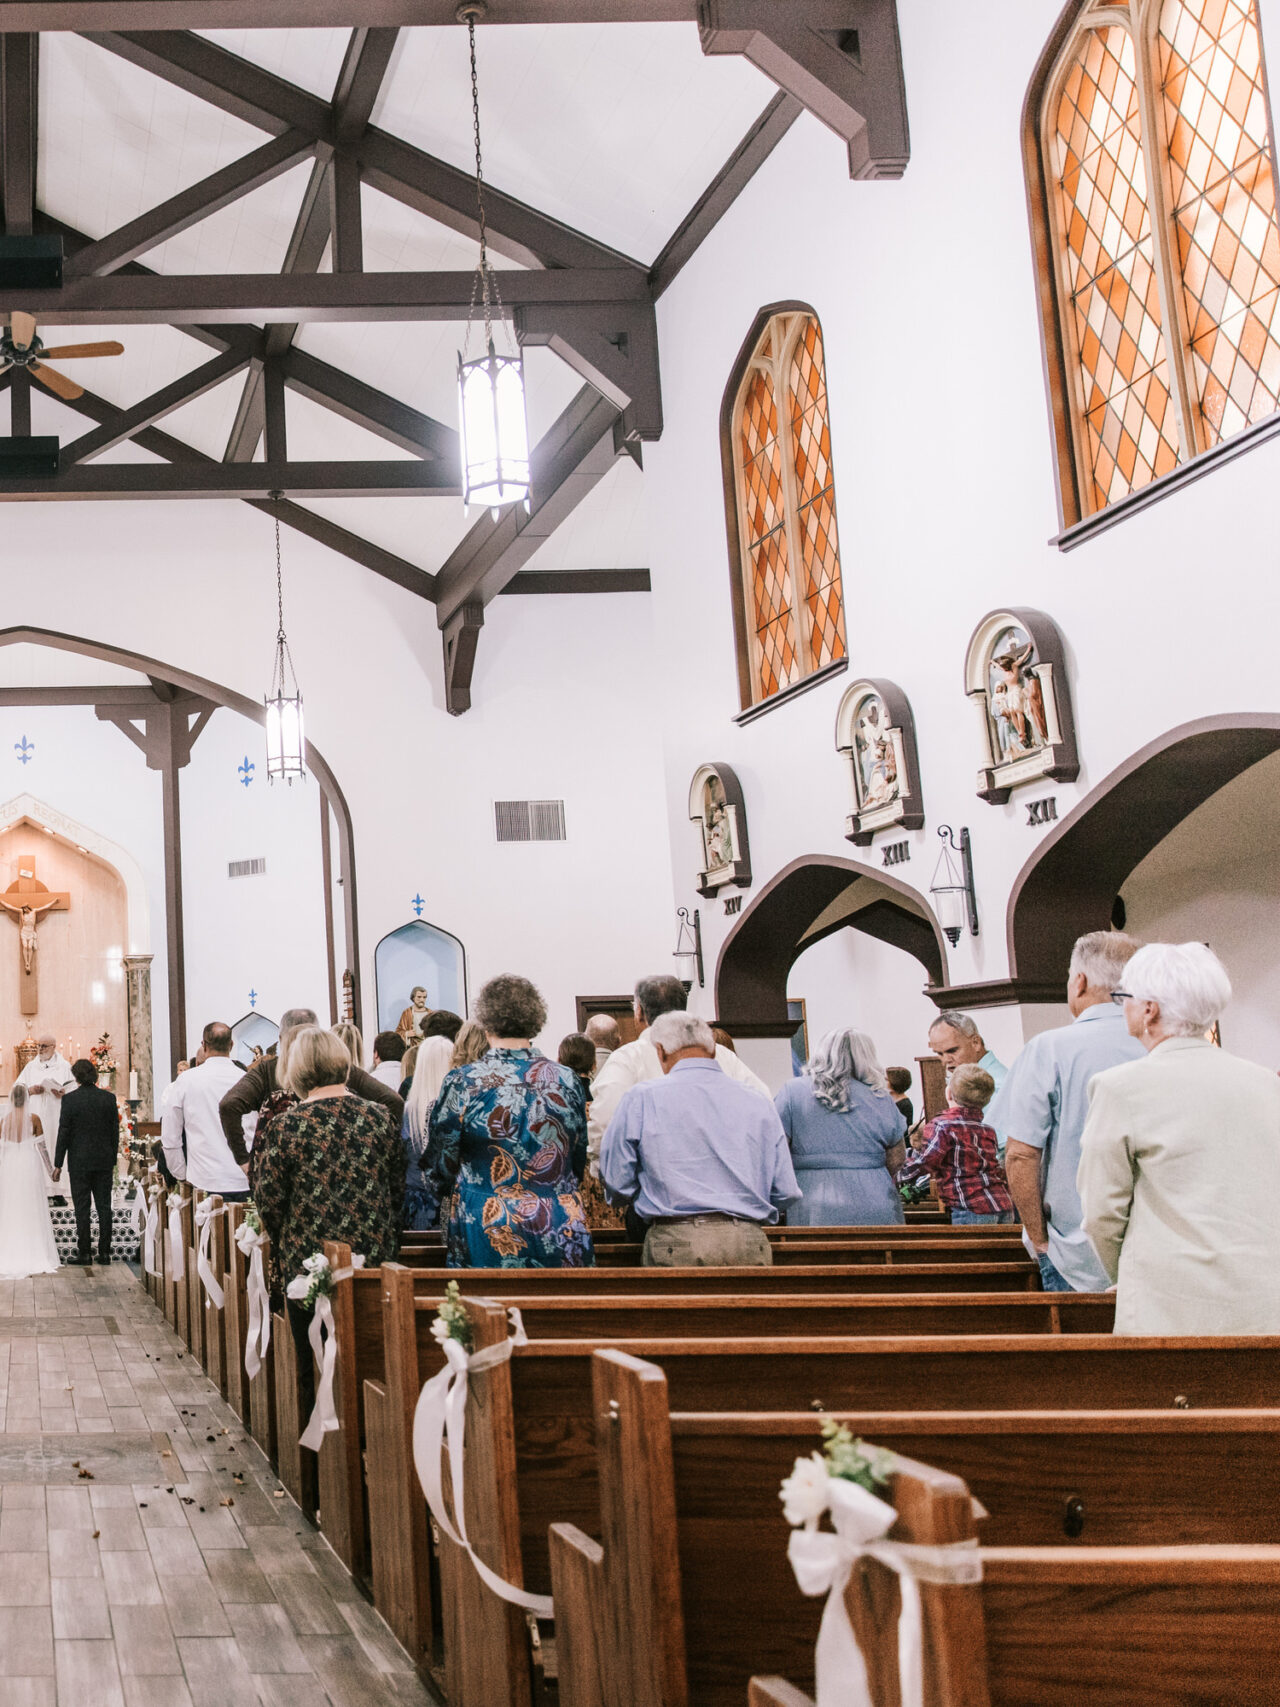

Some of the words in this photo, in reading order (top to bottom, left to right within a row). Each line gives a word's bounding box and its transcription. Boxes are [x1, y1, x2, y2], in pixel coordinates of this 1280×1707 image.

[33, 803, 81, 838] REGNAT
[1025, 797, 1058, 826] XII
[881, 840, 911, 866] XIII
[724, 896, 742, 915] XIV
